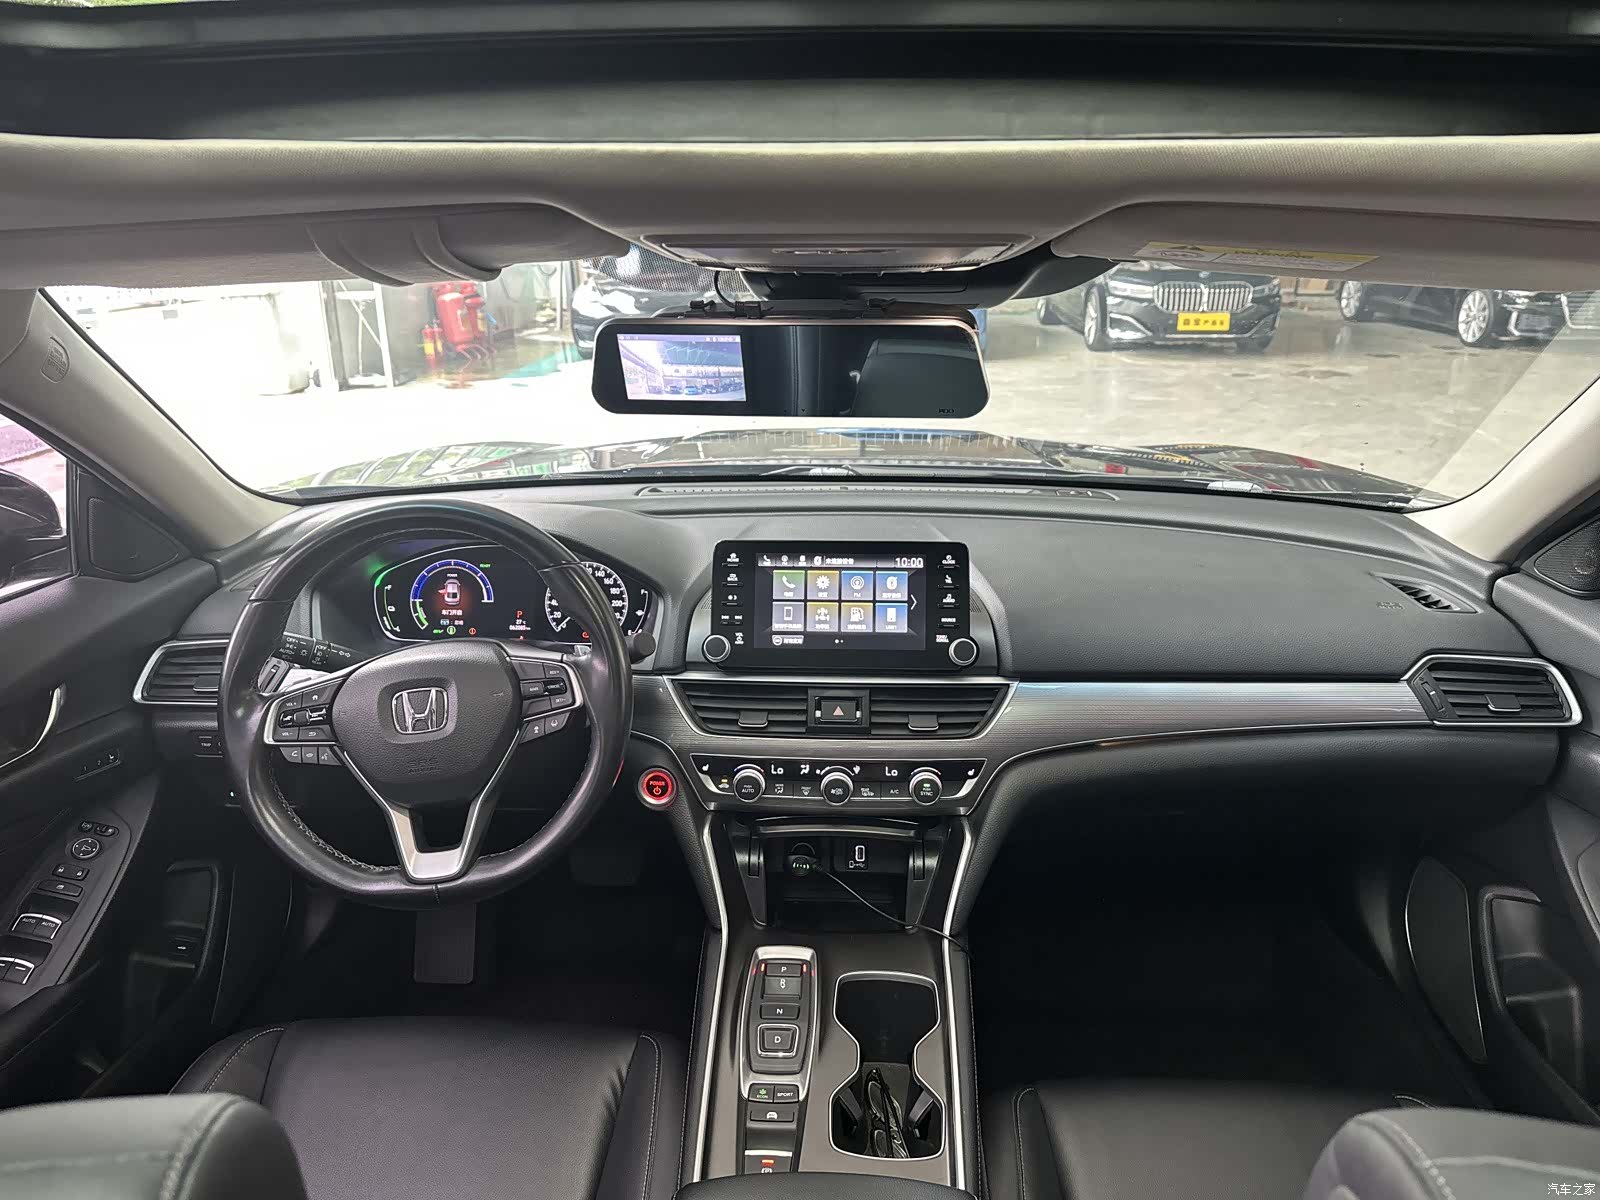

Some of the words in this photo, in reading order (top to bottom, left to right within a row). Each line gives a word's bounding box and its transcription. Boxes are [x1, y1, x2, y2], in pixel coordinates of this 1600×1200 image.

[895, 557, 924, 568] 10:00
[594, 570, 606, 578] 140
[603, 577, 614, 585] 160
[609, 587, 620, 595] 180
[611, 599, 623, 607] 200
[516, 610, 523, 618] P
[553, 611, 562, 619] 20
[771, 764, 784, 775] Lo
[885, 766, 899, 776] Lo
[774, 1035, 782, 1043] D
